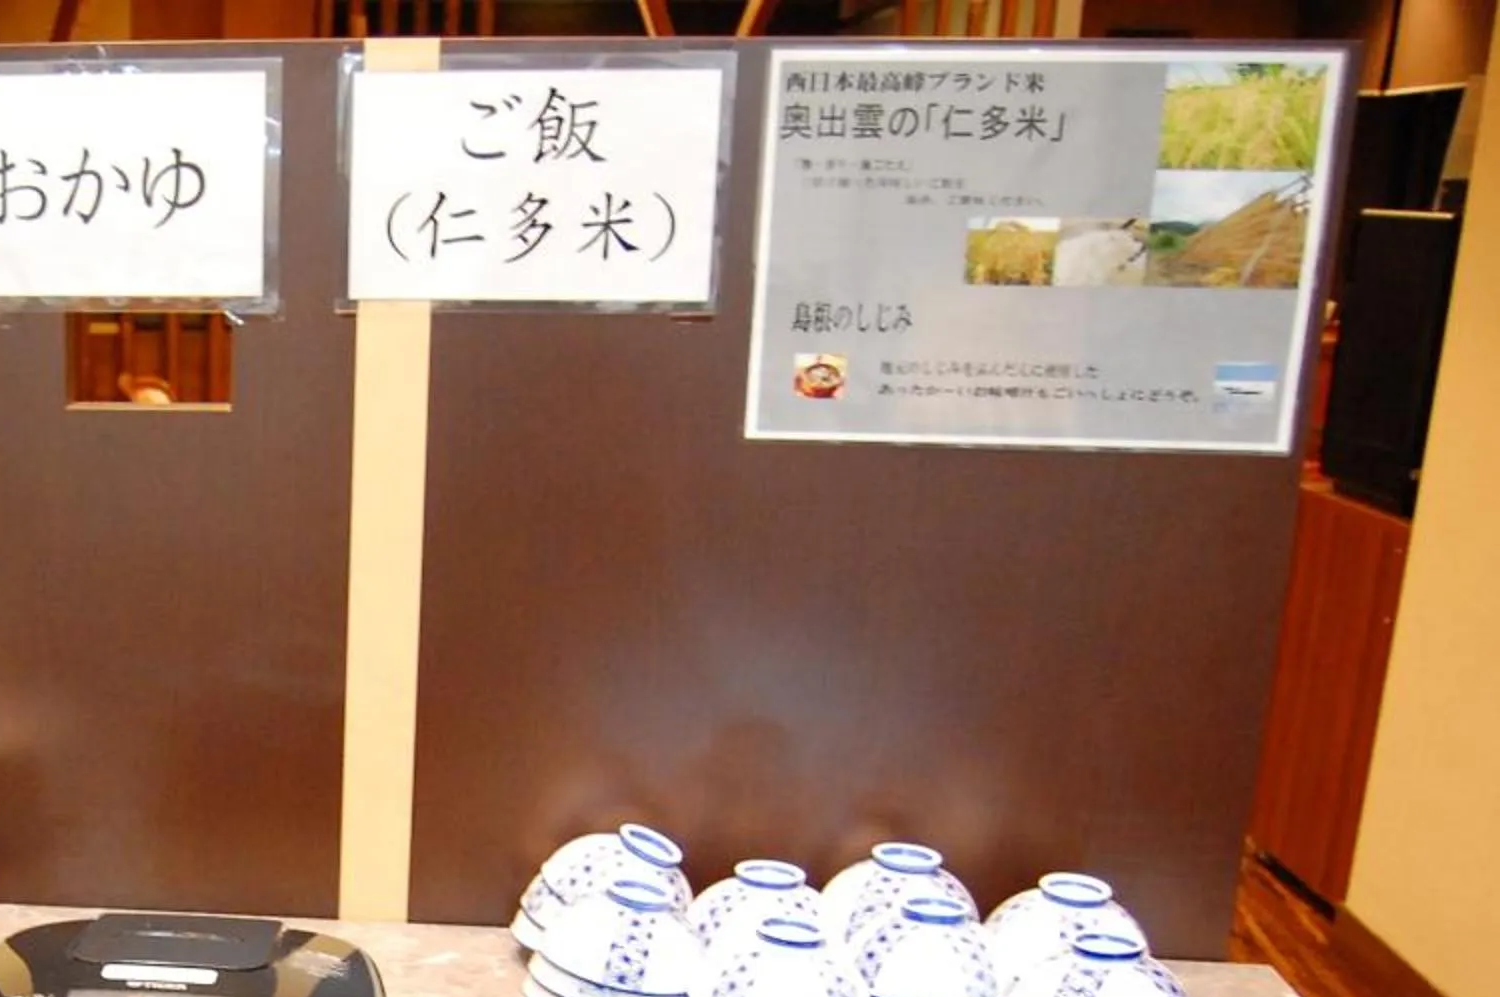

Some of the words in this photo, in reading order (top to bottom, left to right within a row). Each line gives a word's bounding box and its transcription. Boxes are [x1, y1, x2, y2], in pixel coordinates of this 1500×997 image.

[785, 70, 1046, 93] 西日本最高峰ブランド米
[461, 87, 605, 163] ご飯
[779, 102, 1067, 142] 奥出雲の「仁多米」
[385, 190, 677, 263] （仁多米）
